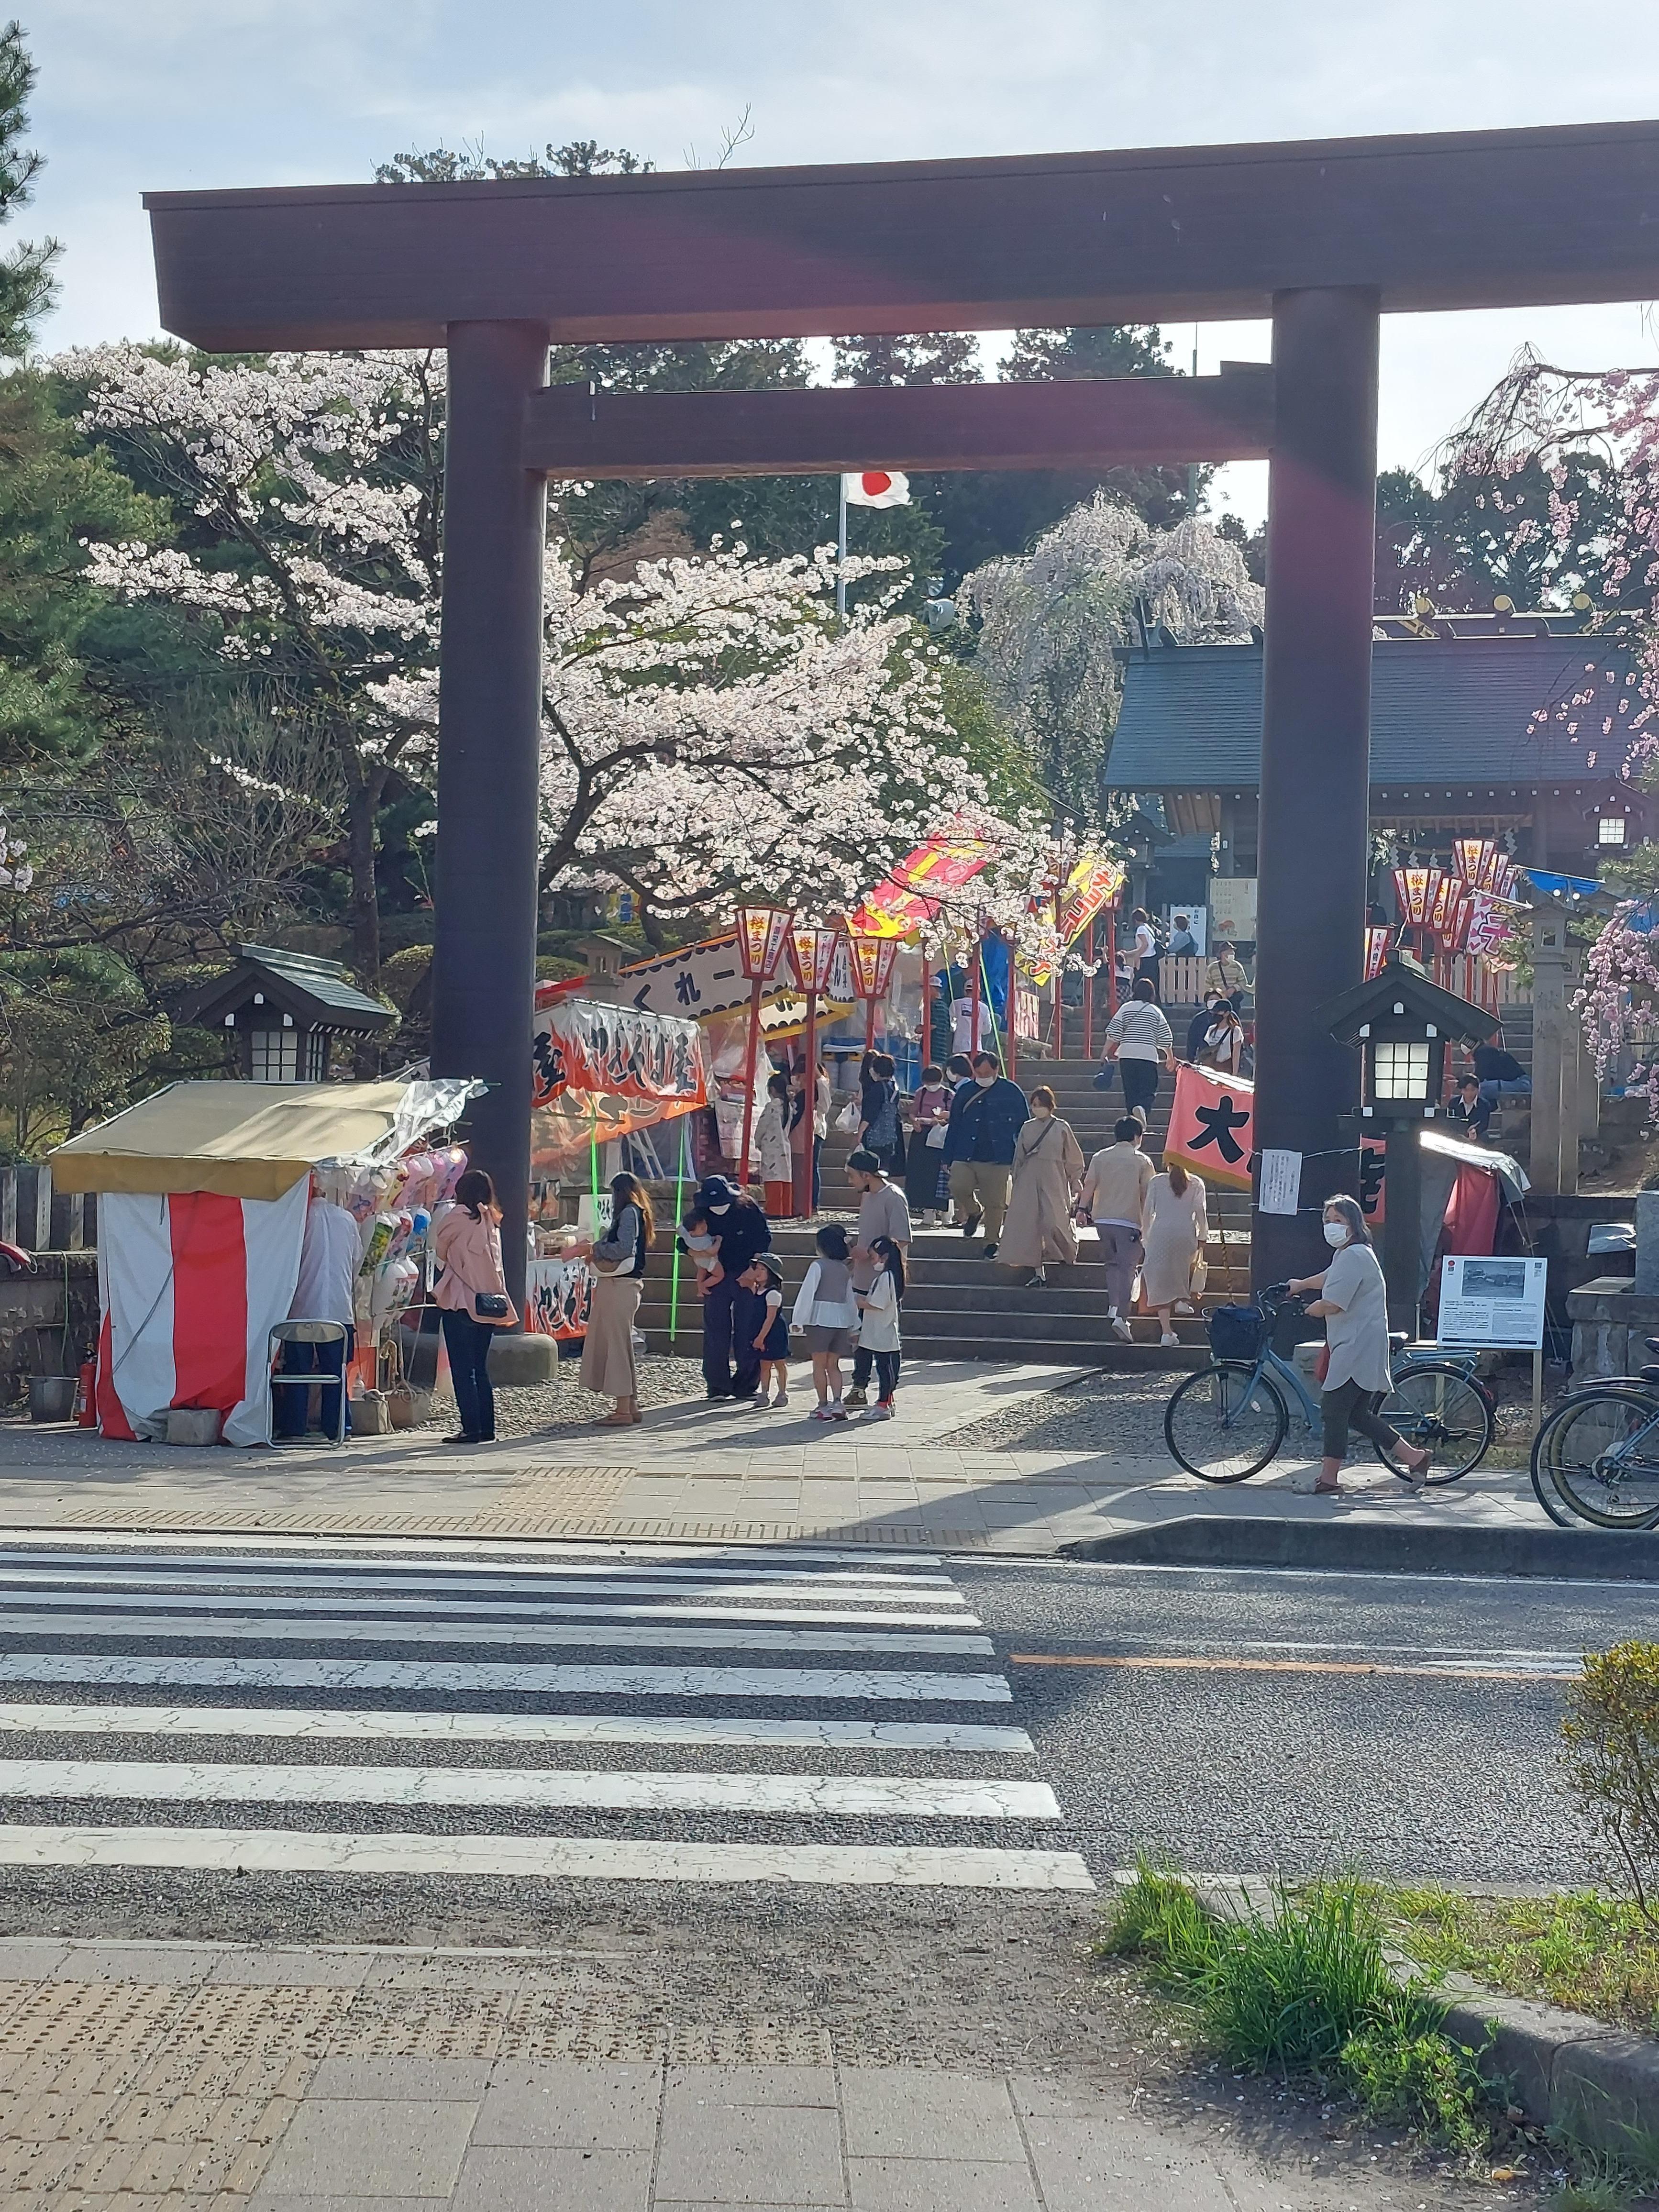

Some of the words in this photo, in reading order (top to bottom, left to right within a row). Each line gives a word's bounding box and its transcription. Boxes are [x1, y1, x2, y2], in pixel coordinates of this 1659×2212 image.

[1467, 844, 1478, 880] 桜まつり
[1410, 874, 1424, 915] 桜まつり
[750, 915, 764, 965] 桜まつり
[798, 936, 812, 982] 桜まつり
[861, 943, 877, 986] 桜まつり
